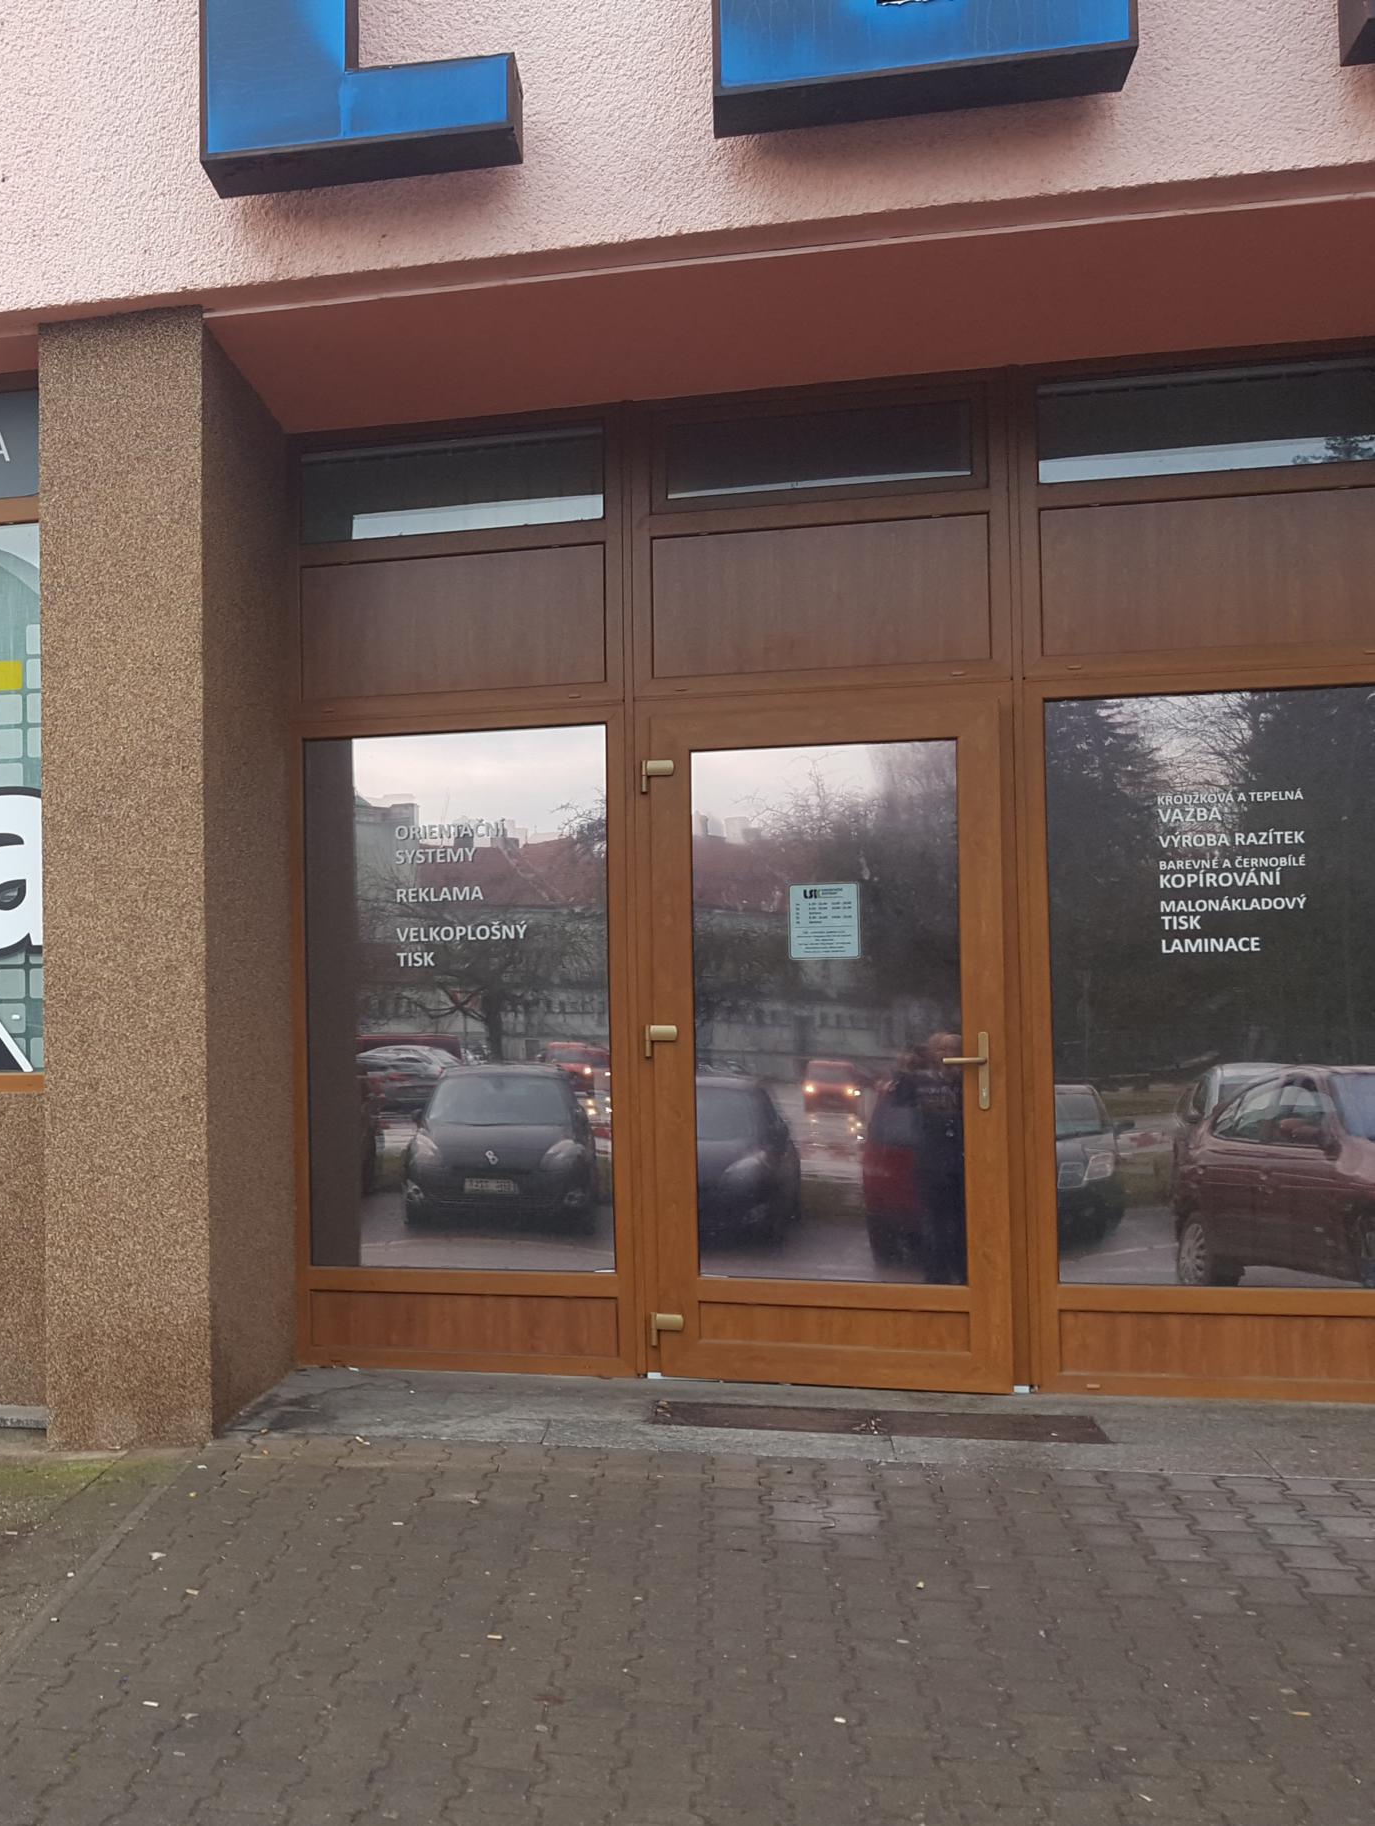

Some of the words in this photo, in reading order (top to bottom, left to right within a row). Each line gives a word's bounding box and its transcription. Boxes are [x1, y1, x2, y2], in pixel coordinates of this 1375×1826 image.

[1249, 788, 1304, 802] TEPELNÁ
[1159, 832, 1230, 848] VÝROBA
[1235, 828, 1305, 846] RAZÍTEK
[1159, 858, 1219, 871] BAREVNÉ
[1222, 859, 1232, 869] A
[1234, 854, 1307, 868] ČERNOBÍLÉ
[1159, 867, 1282, 888] KOPÍROVÁNÍ
[396, 886, 484, 903] REKLAMA
[1160, 894, 1307, 913] MALONÁKLADOVÝ
[396, 920, 527, 942] VELKOPLOŠNÝ
[1161, 915, 1202, 931] TISK
[1161, 936, 1261, 953] LAMINACE
[396, 951, 435, 968] TISK
